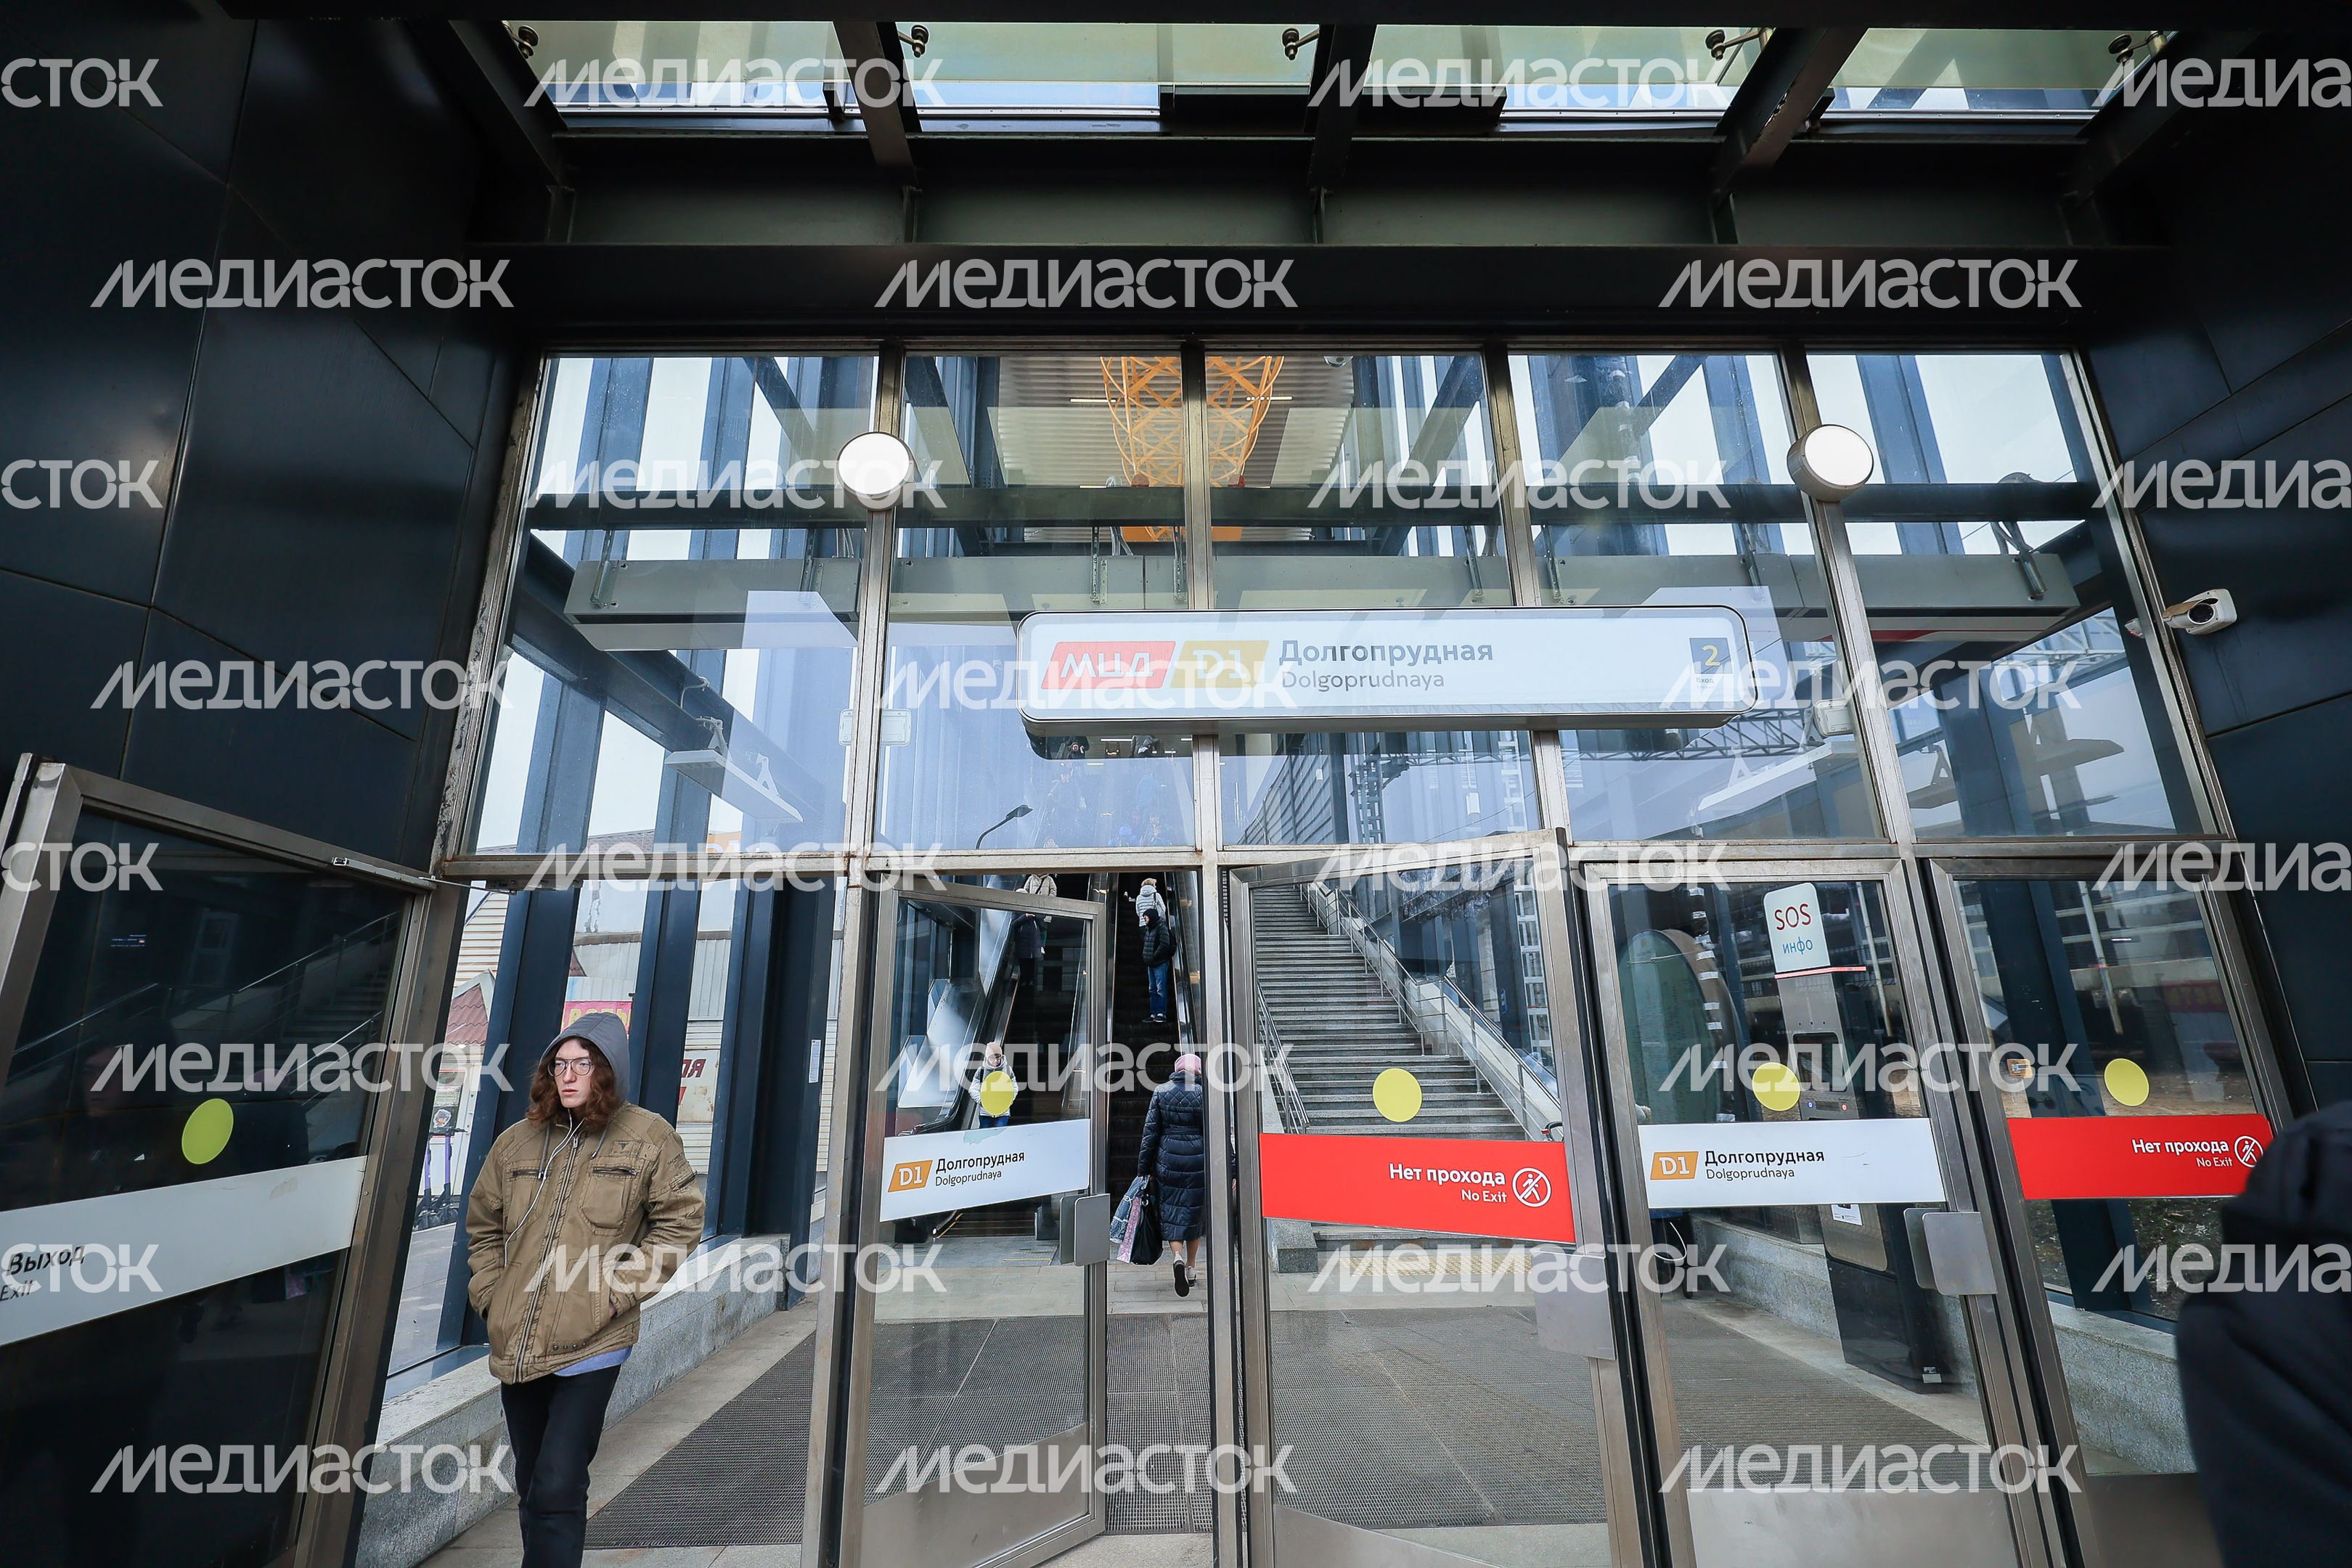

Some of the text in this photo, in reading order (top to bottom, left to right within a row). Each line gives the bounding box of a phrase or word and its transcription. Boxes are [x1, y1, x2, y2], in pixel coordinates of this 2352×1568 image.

[1279, 640, 1493, 666] Долгопрудная
[1702, 645, 1721, 666] 2
[1061, 652, 1153, 678] МЦД
[1192, 649, 1247, 679] D1
[1282, 670, 1445, 692] Dolgoprudnaya
[1774, 903, 1811, 931] SOS
[1783, 936, 1813, 955] инфо
[2131, 1139, 2230, 1156] Нет прохода
[936, 1152, 1025, 1174] Долгопрудная
[1659, 1156, 1690, 1175] D1
[1704, 1151, 1825, 1167] Долгопрудная
[2196, 1157, 2232, 1167] No Exit
[898, 1166, 923, 1186] D1
[935, 1169, 1002, 1186] Dolgoprudnaya
[1389, 1162, 1506, 1187] Нет прохода
[1706, 1167, 1795, 1181] Dolgoprudnaya
[1461, 1189, 1507, 1203] No Exit
[6, 1245, 86, 1276] Выход
[0, 1280, 33, 1302] Exit
